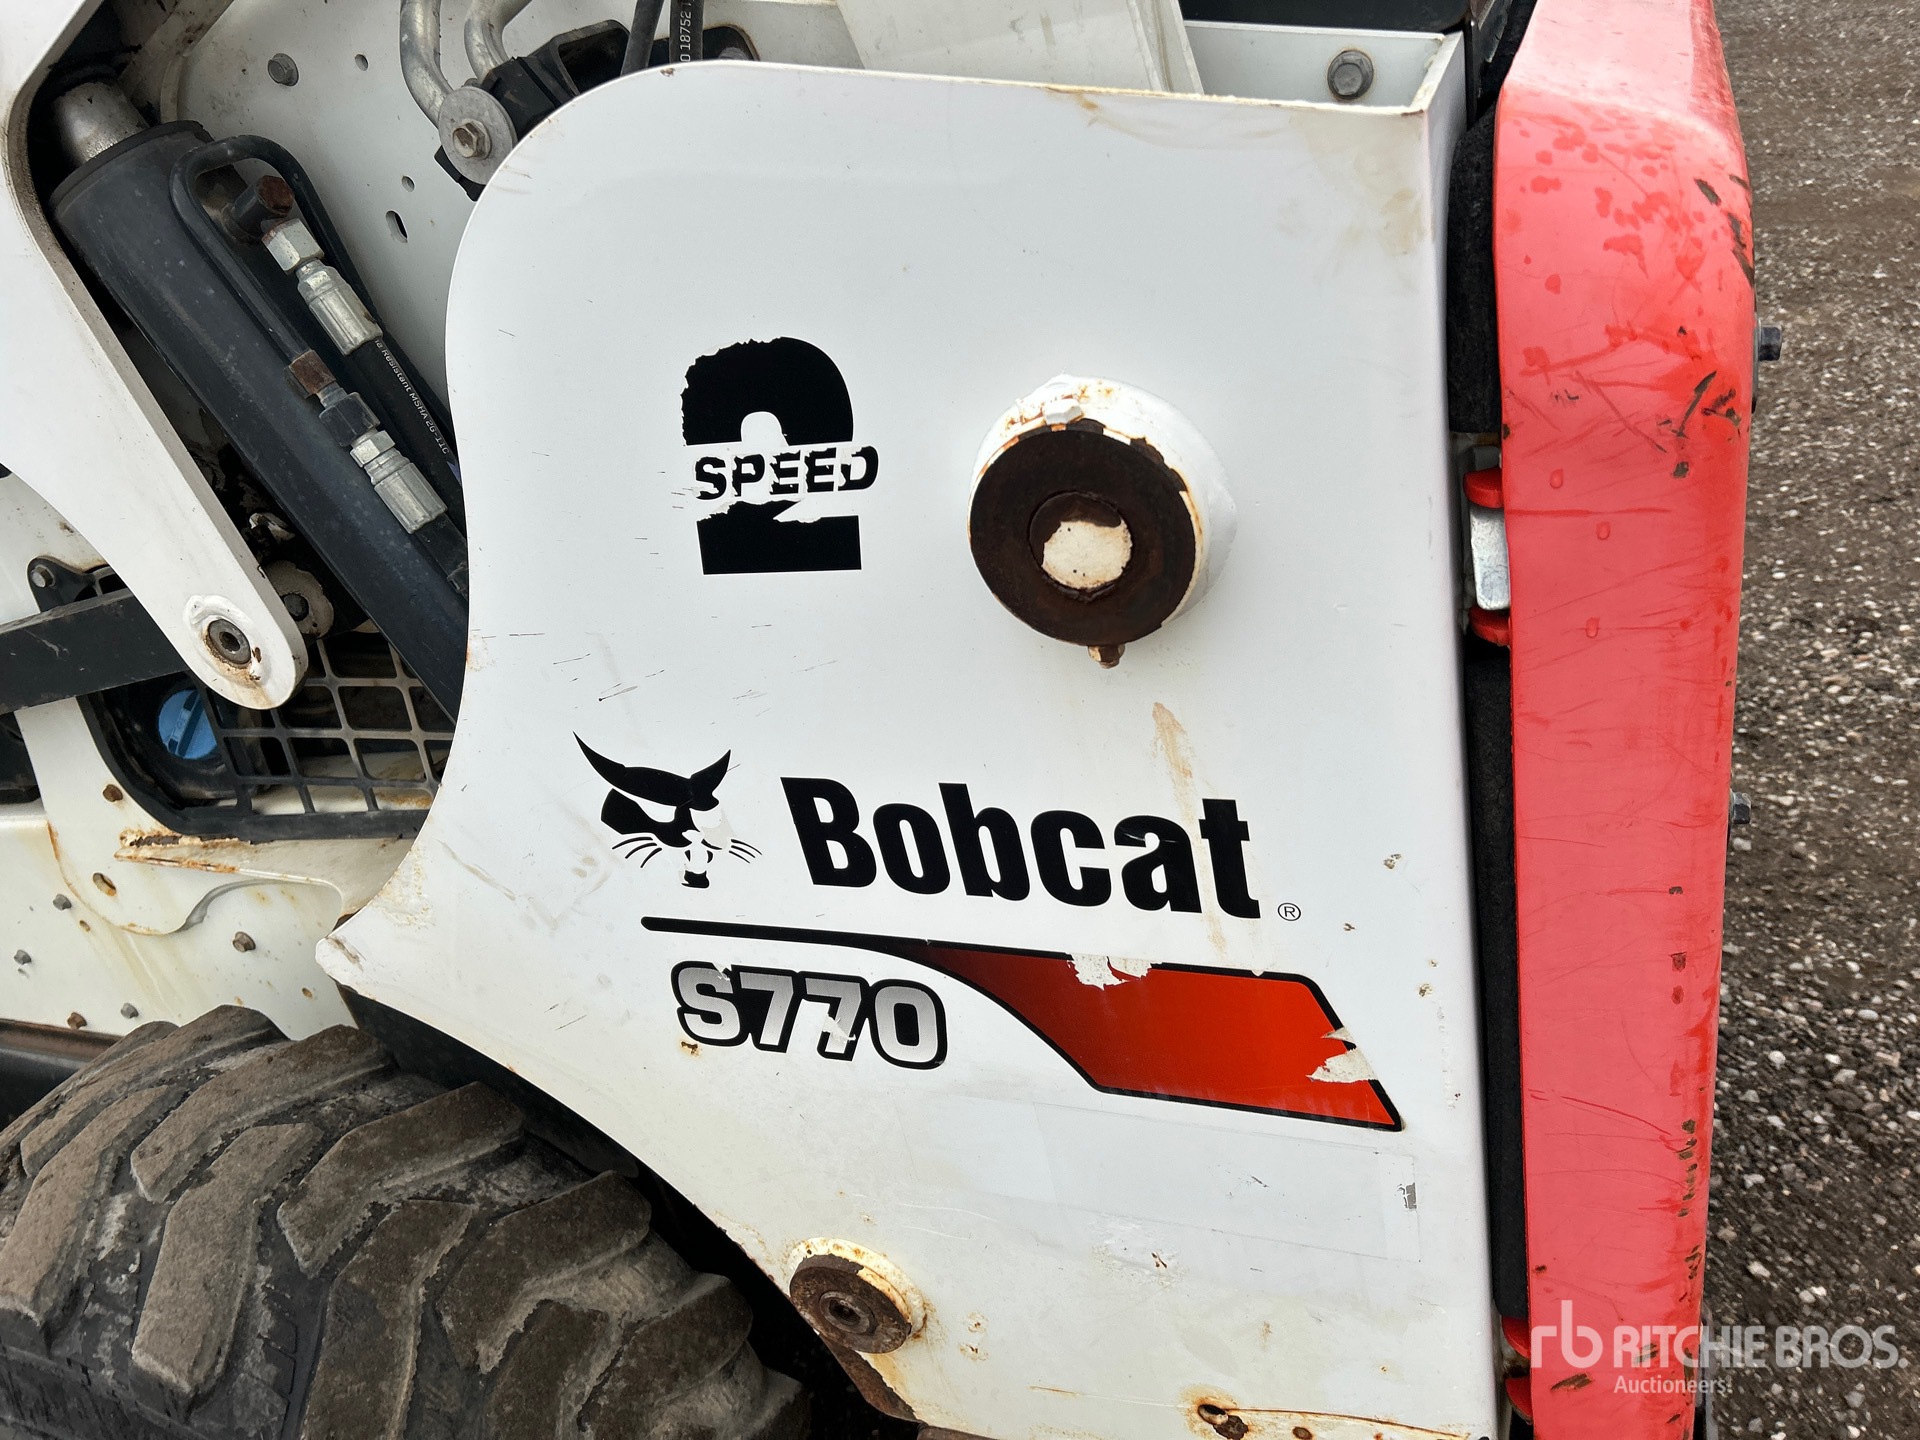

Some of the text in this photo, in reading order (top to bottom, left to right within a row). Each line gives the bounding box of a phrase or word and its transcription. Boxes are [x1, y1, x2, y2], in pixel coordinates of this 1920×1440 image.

[680, 11, 691, 50] 18752
[382, 349, 412, 392] Resistant
[409, 392, 428, 420] MSHA
[680, 336, 862, 575] 2
[695, 446, 879, 500] SPEED
[780, 777, 1261, 919] Bobcat
[671, 961, 947, 1070] S770
